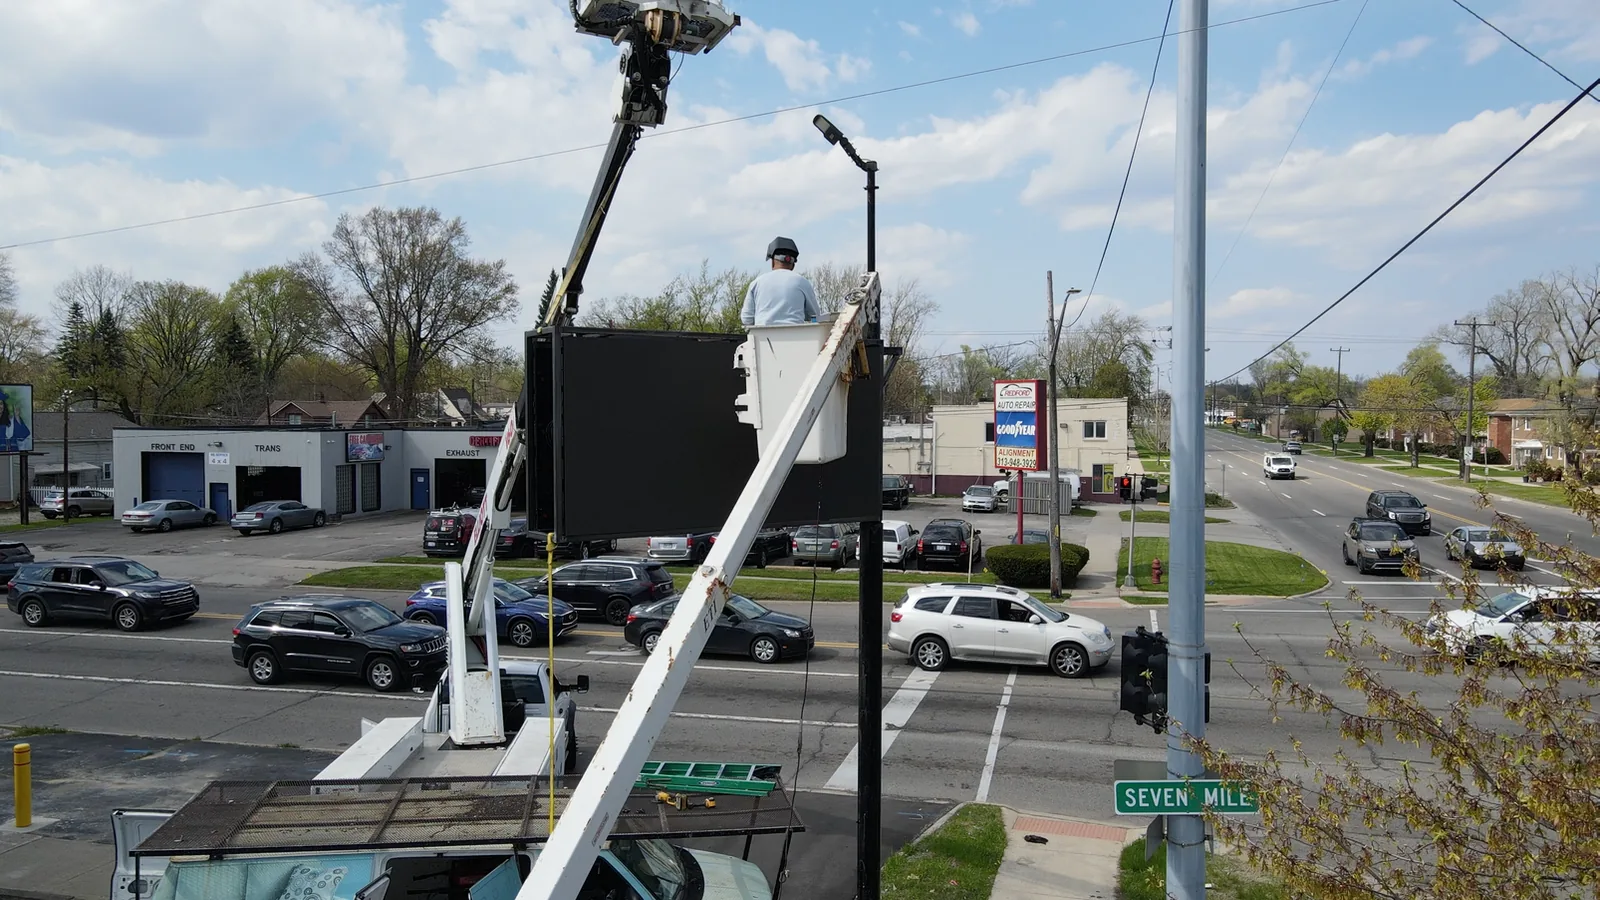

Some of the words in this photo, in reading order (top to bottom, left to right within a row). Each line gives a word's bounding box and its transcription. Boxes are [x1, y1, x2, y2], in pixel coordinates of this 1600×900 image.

[997, 401, 1013, 409] AUTO
[1014, 401, 1036, 409] REPAIR
[996, 421, 1036, 438] GOODYEAR
[445, 449, 480, 457] EXHAUST
[998, 449, 1034, 457] ALIGNMENT
[997, 458, 1036, 468] 313-948-3929
[1125, 788, 1188, 807] SEVEN
[1204, 788, 1251, 806] MILE
